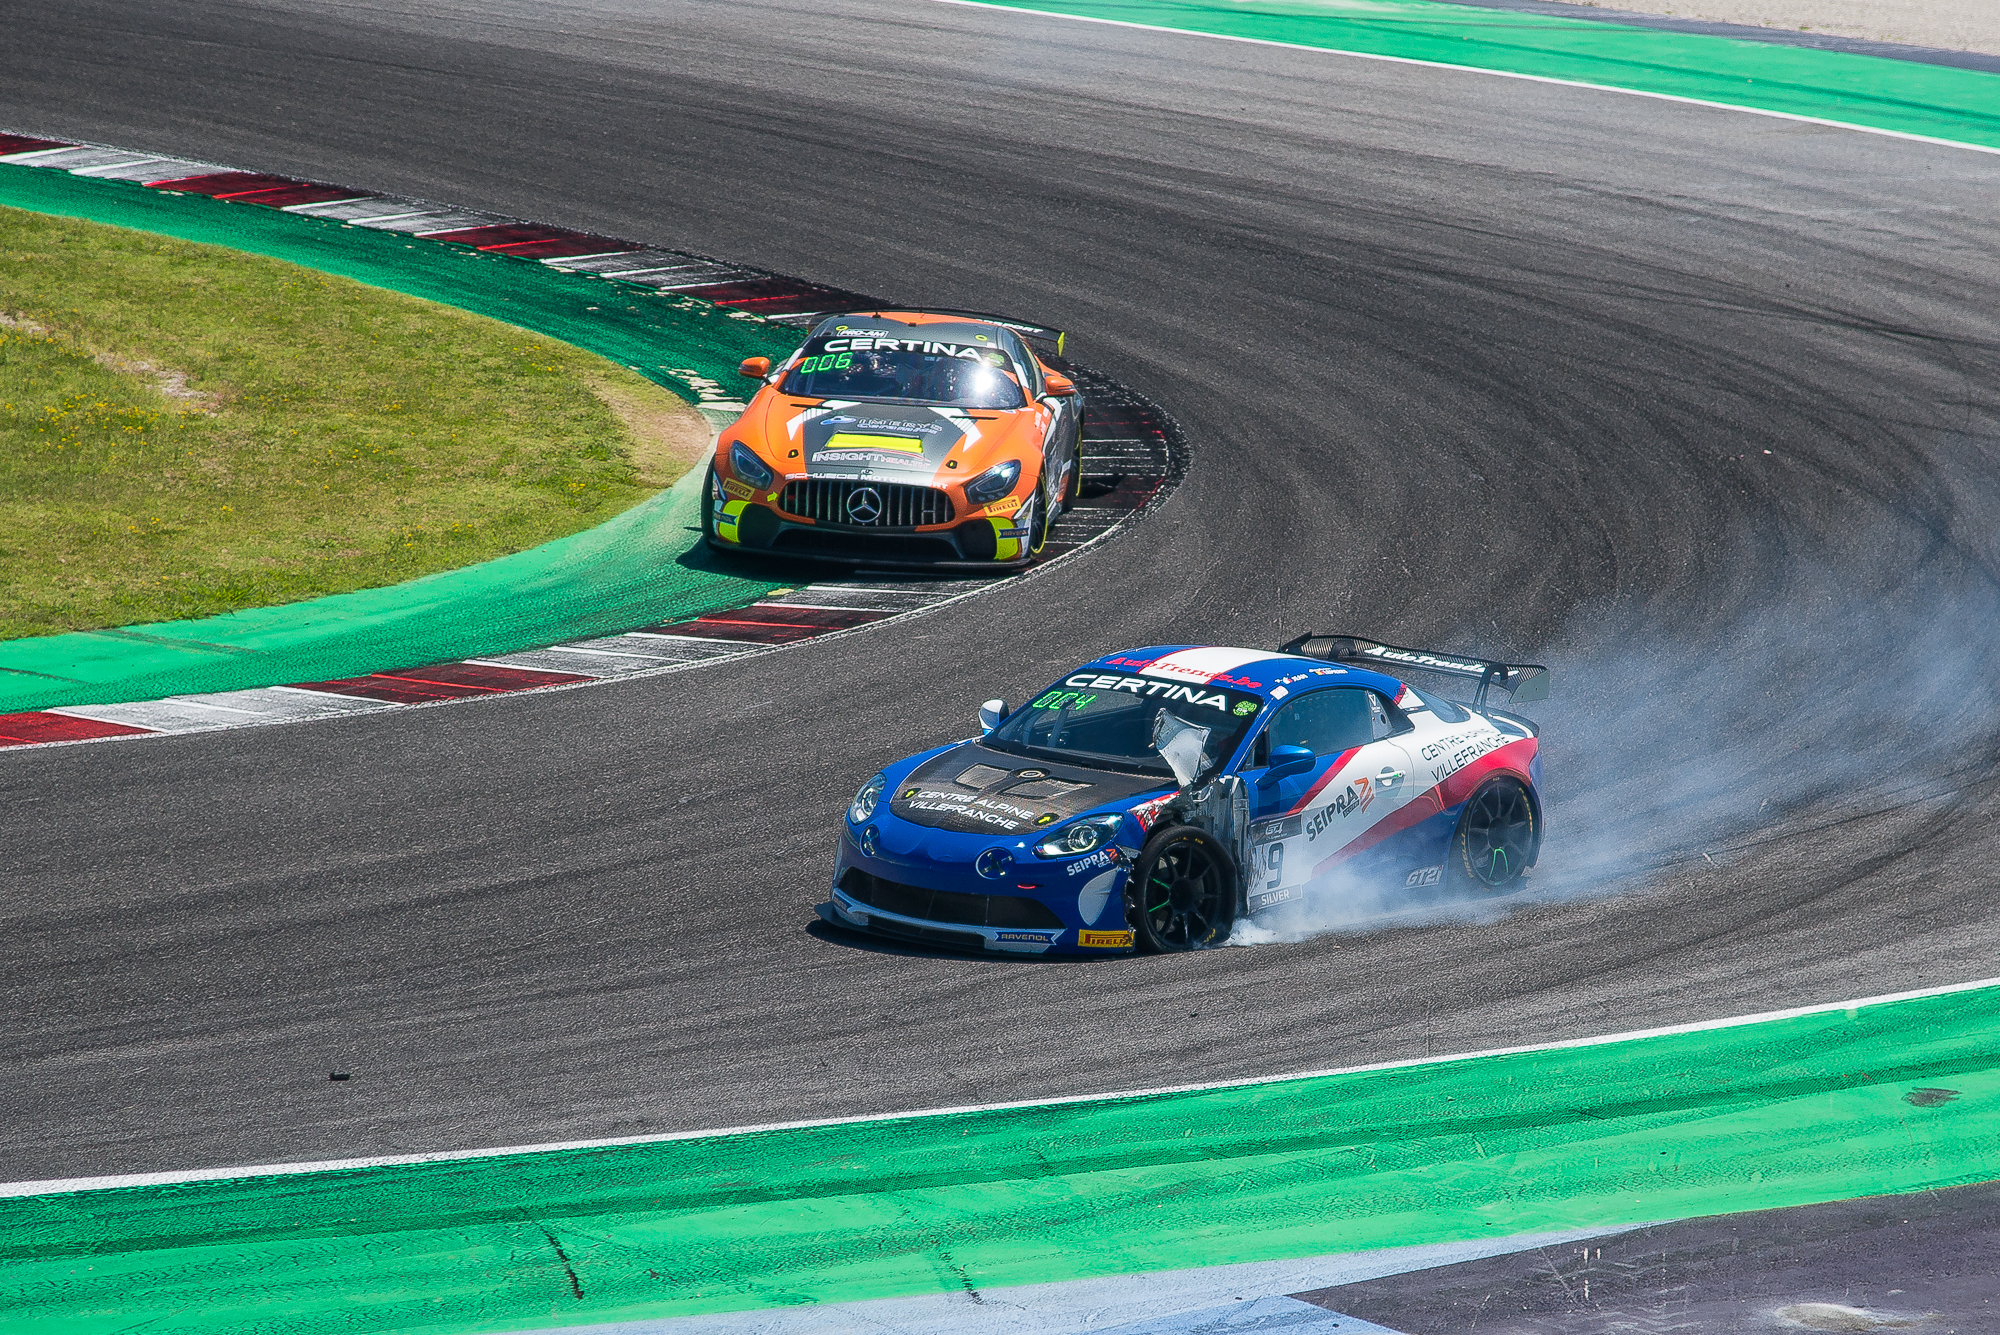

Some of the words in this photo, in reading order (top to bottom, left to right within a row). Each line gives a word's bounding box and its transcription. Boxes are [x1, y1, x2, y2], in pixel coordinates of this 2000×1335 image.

[801, 352, 853, 374] 006
[824, 338, 983, 361] CERTINA
[1105, 656, 1263, 689] AutoTrends.be
[1065, 674, 1227, 712] CERTINA
[1430, 733, 1510, 782] VILLEFRANCHE
[908, 801, 1019, 830] VILLEFRANCHE
[917, 791, 978, 802] CENTRE
[974, 799, 1035, 820] ALPINE
[1306, 785, 1359, 842] SEIPRA
[1066, 850, 1109, 876] SEIPRA
[1261, 889, 1290, 905] SILVER
[1001, 933, 1049, 942] RAVENOL
